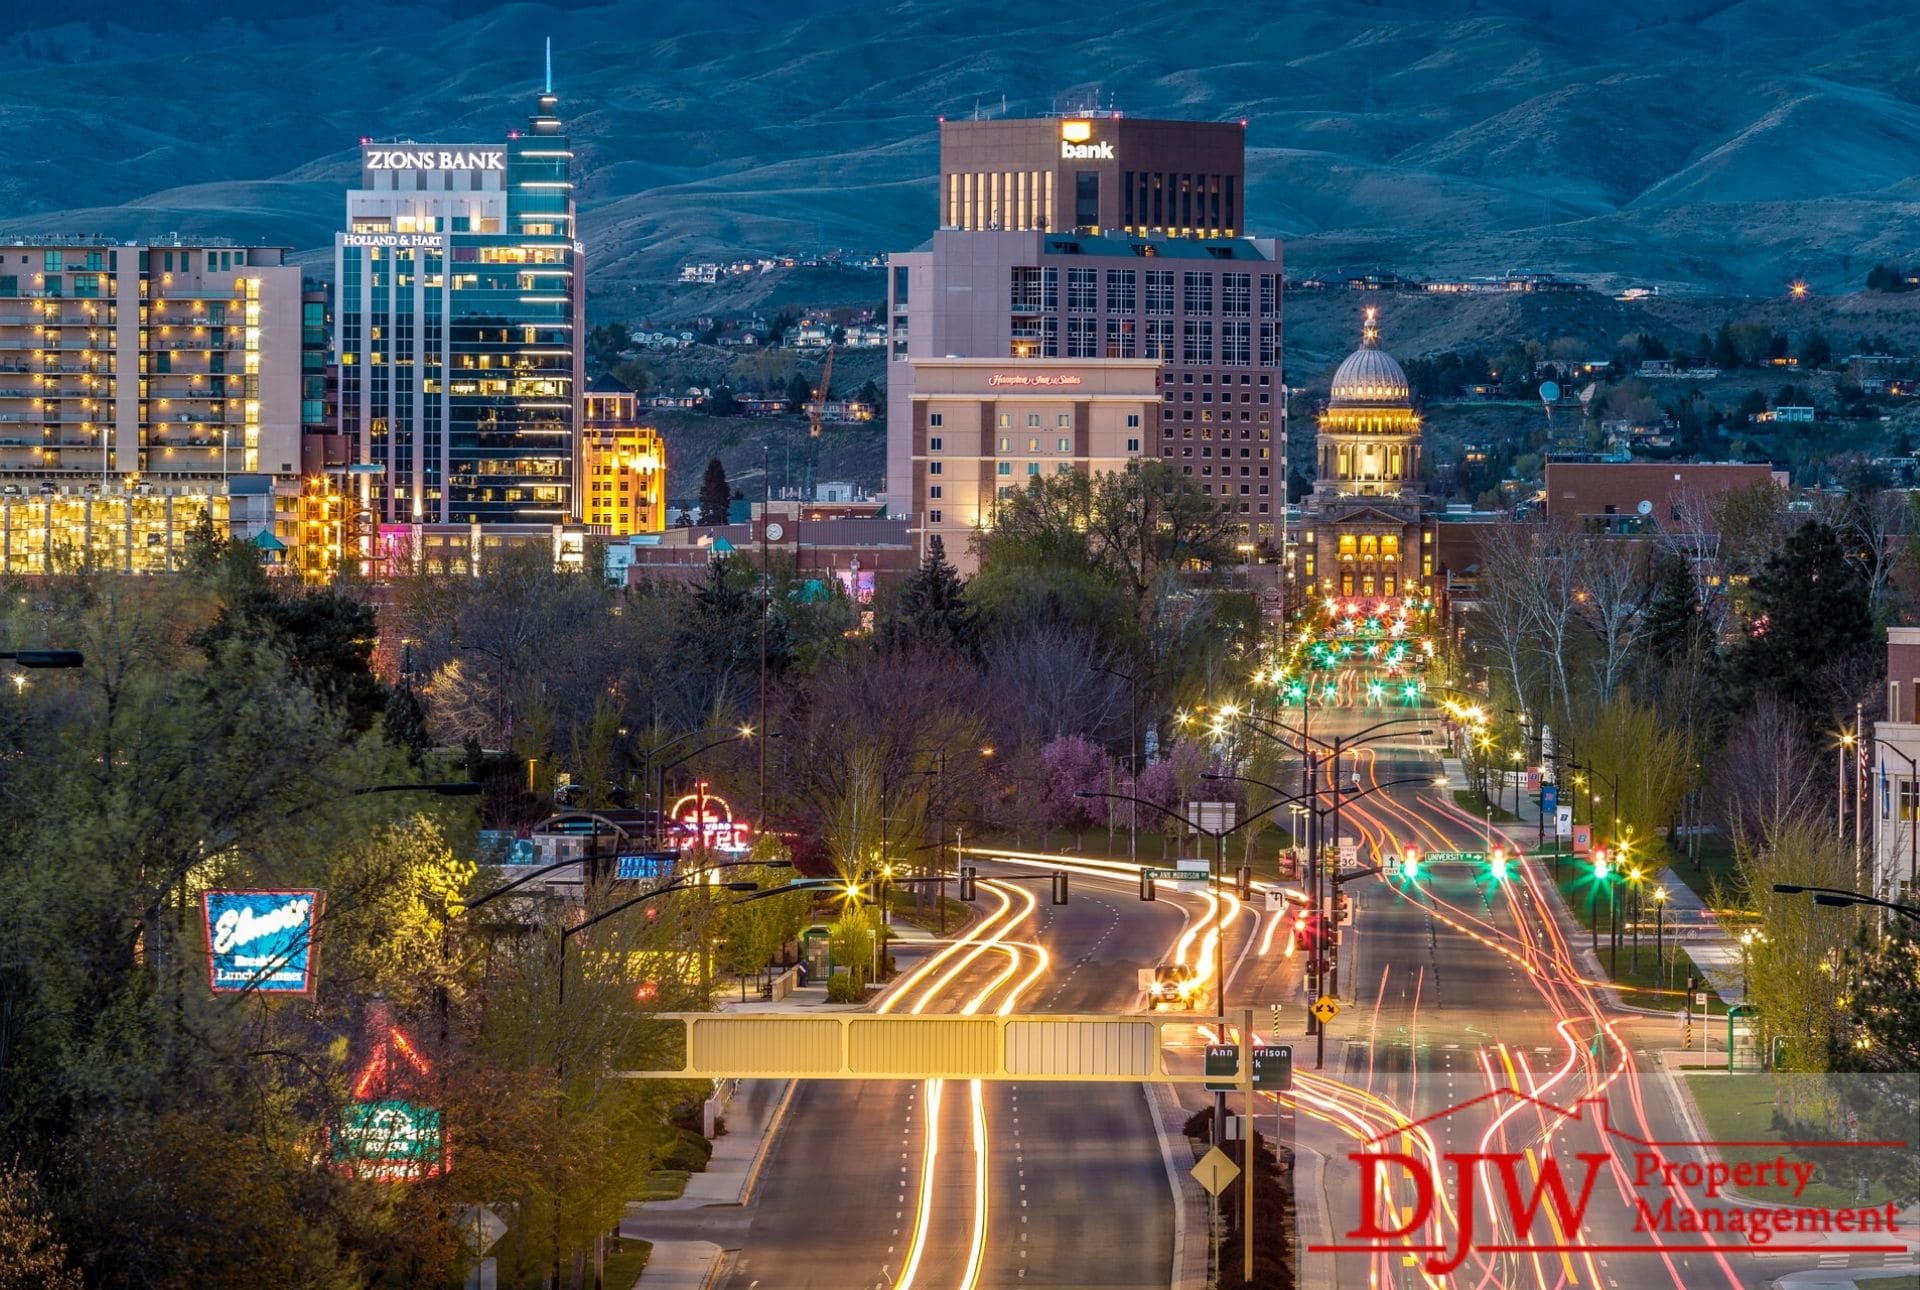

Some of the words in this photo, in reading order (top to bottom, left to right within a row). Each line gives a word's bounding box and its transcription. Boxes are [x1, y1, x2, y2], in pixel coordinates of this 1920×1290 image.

[1061, 141, 1114, 159] bank
[367, 151, 434, 170] ZIONS
[438, 151, 505, 170] BANK
[399, 234, 409, 246] &
[412, 235, 442, 246] HART
[1427, 853, 1464, 861] UNIVERSITY
[1341, 858, 1355, 867] 30
[1160, 871, 1171, 879] ANN
[1173, 871, 1200, 880] MORRISON
[1211, 1048, 1233, 1057] Ann
[1250, 1048, 1287, 1057] rrison
[1236, 1059, 1261, 1069] Pk
